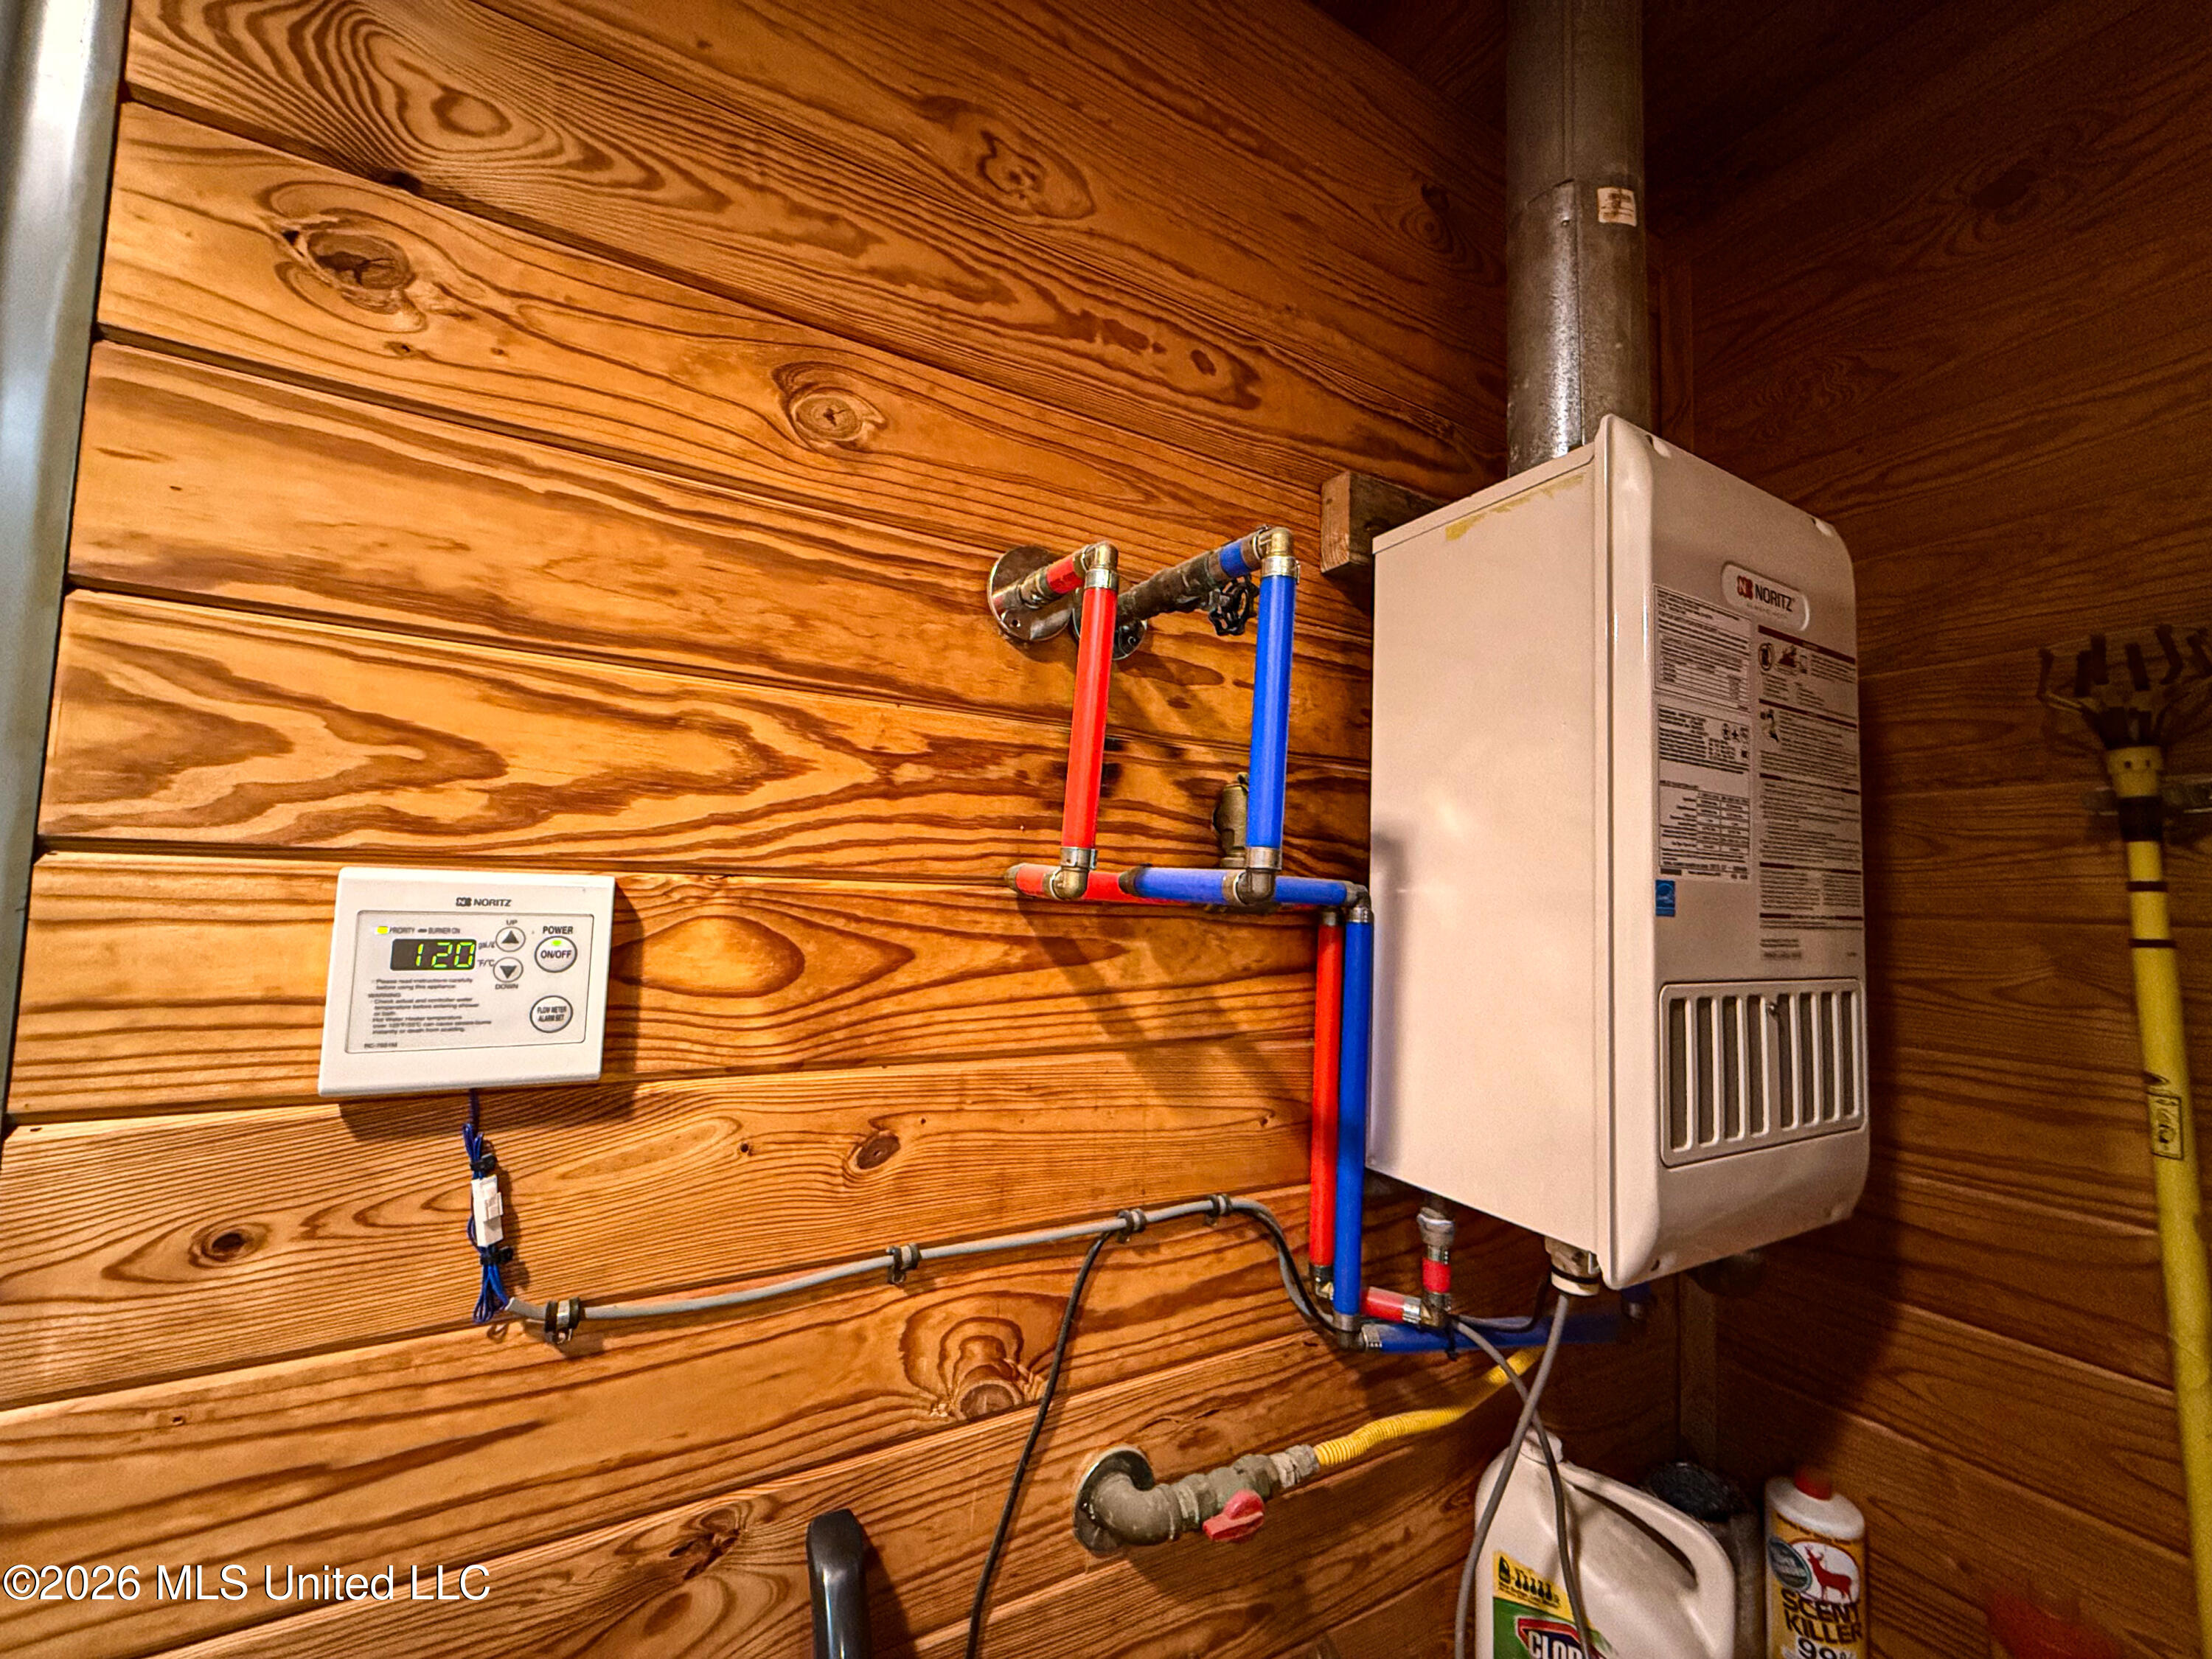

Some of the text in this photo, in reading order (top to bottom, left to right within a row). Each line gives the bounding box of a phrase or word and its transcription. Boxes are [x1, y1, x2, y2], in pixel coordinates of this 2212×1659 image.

[1755, 584, 1792, 612] NORITZ
[473, 899, 512, 907] NORITZ
[543, 926, 573, 934] POWER
[415, 942, 476, 968] 120
[540, 950, 571, 959] ON/OFF
[538, 1006, 566, 1015] FLOW METER
[556, 1014, 564, 1022] SET
[1781, 1588, 1860, 1622] SCENT
[1784, 1609, 1863, 1644] KILLER
